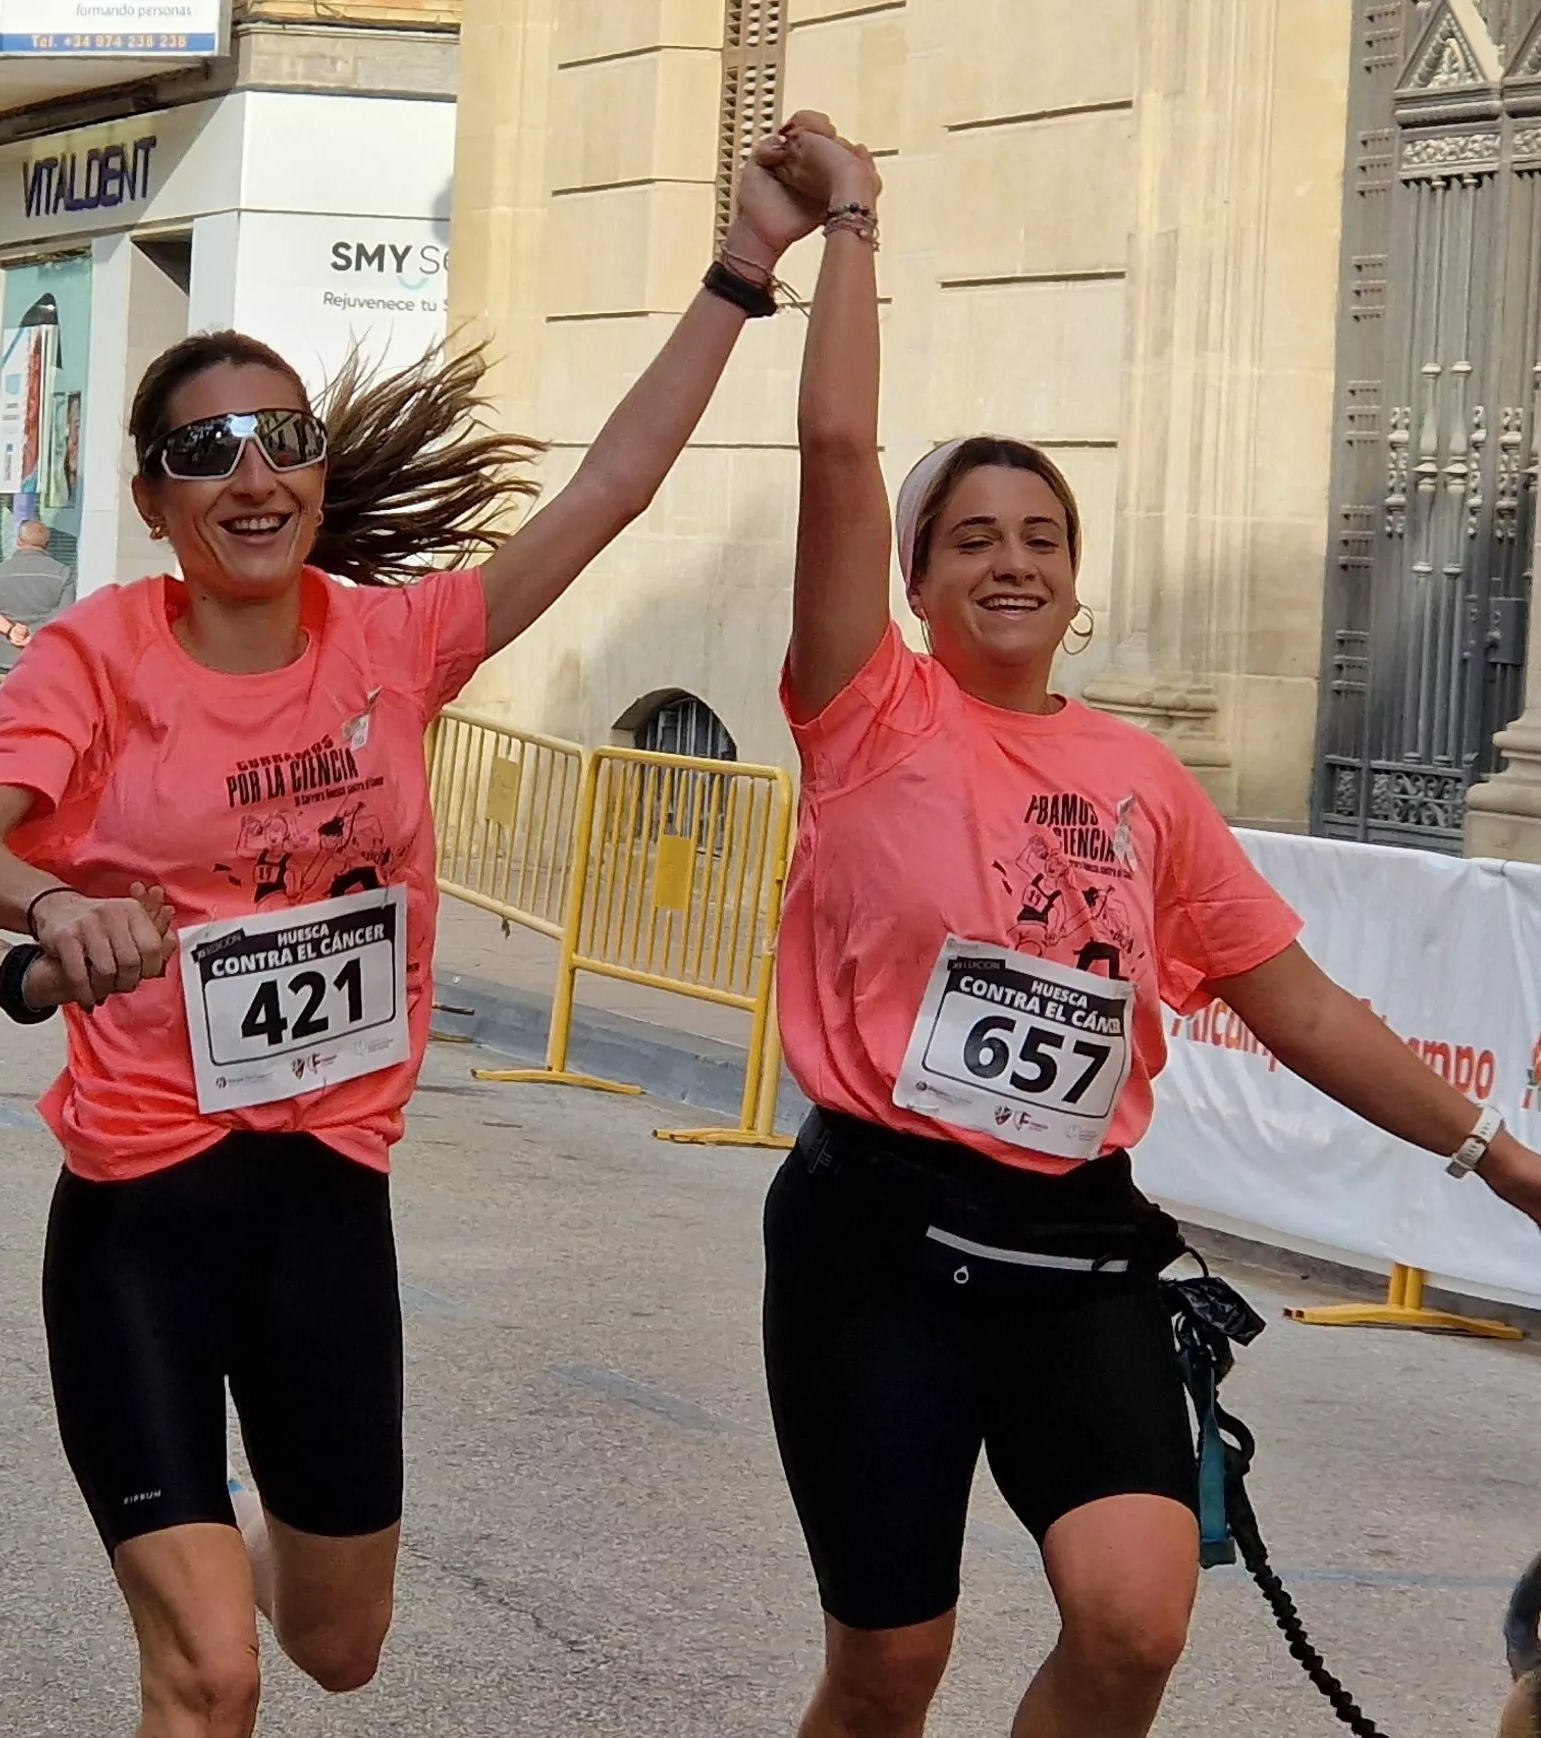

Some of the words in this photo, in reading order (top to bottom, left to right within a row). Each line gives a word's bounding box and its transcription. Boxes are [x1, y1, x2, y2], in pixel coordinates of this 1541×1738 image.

[75, 4, 134, 16] formando
[137, 5, 191, 19] personas
[31, 34, 57, 48] Tel.
[63, 34, 90, 48] +34
[127, 34, 155, 48] 238
[159, 34, 187, 48] 238
[22, 135, 157, 218] VITALDENT
[331, 241, 412, 273] SMY
[419, 245, 449, 275] S
[323, 291, 415, 311] Rejuvenece
[421, 299, 437, 311] tu
[225, 770, 261, 809] POR
[265, 764, 286, 800] LA
[289, 747, 359, 793] CIENCIA
[211, 947, 294, 978] CONTRA
[297, 944, 318, 963] EL
[319, 922, 386, 957] CÁNCER
[277, 922, 330, 948] HUESCA
[240, 956, 364, 1048] 421
[959, 975, 1041, 1015] CONTRA
[1044, 1002, 1067, 1023] EL
[1031, 980, 1088, 1009] HUESCA
[962, 1014, 1112, 1106] 657
